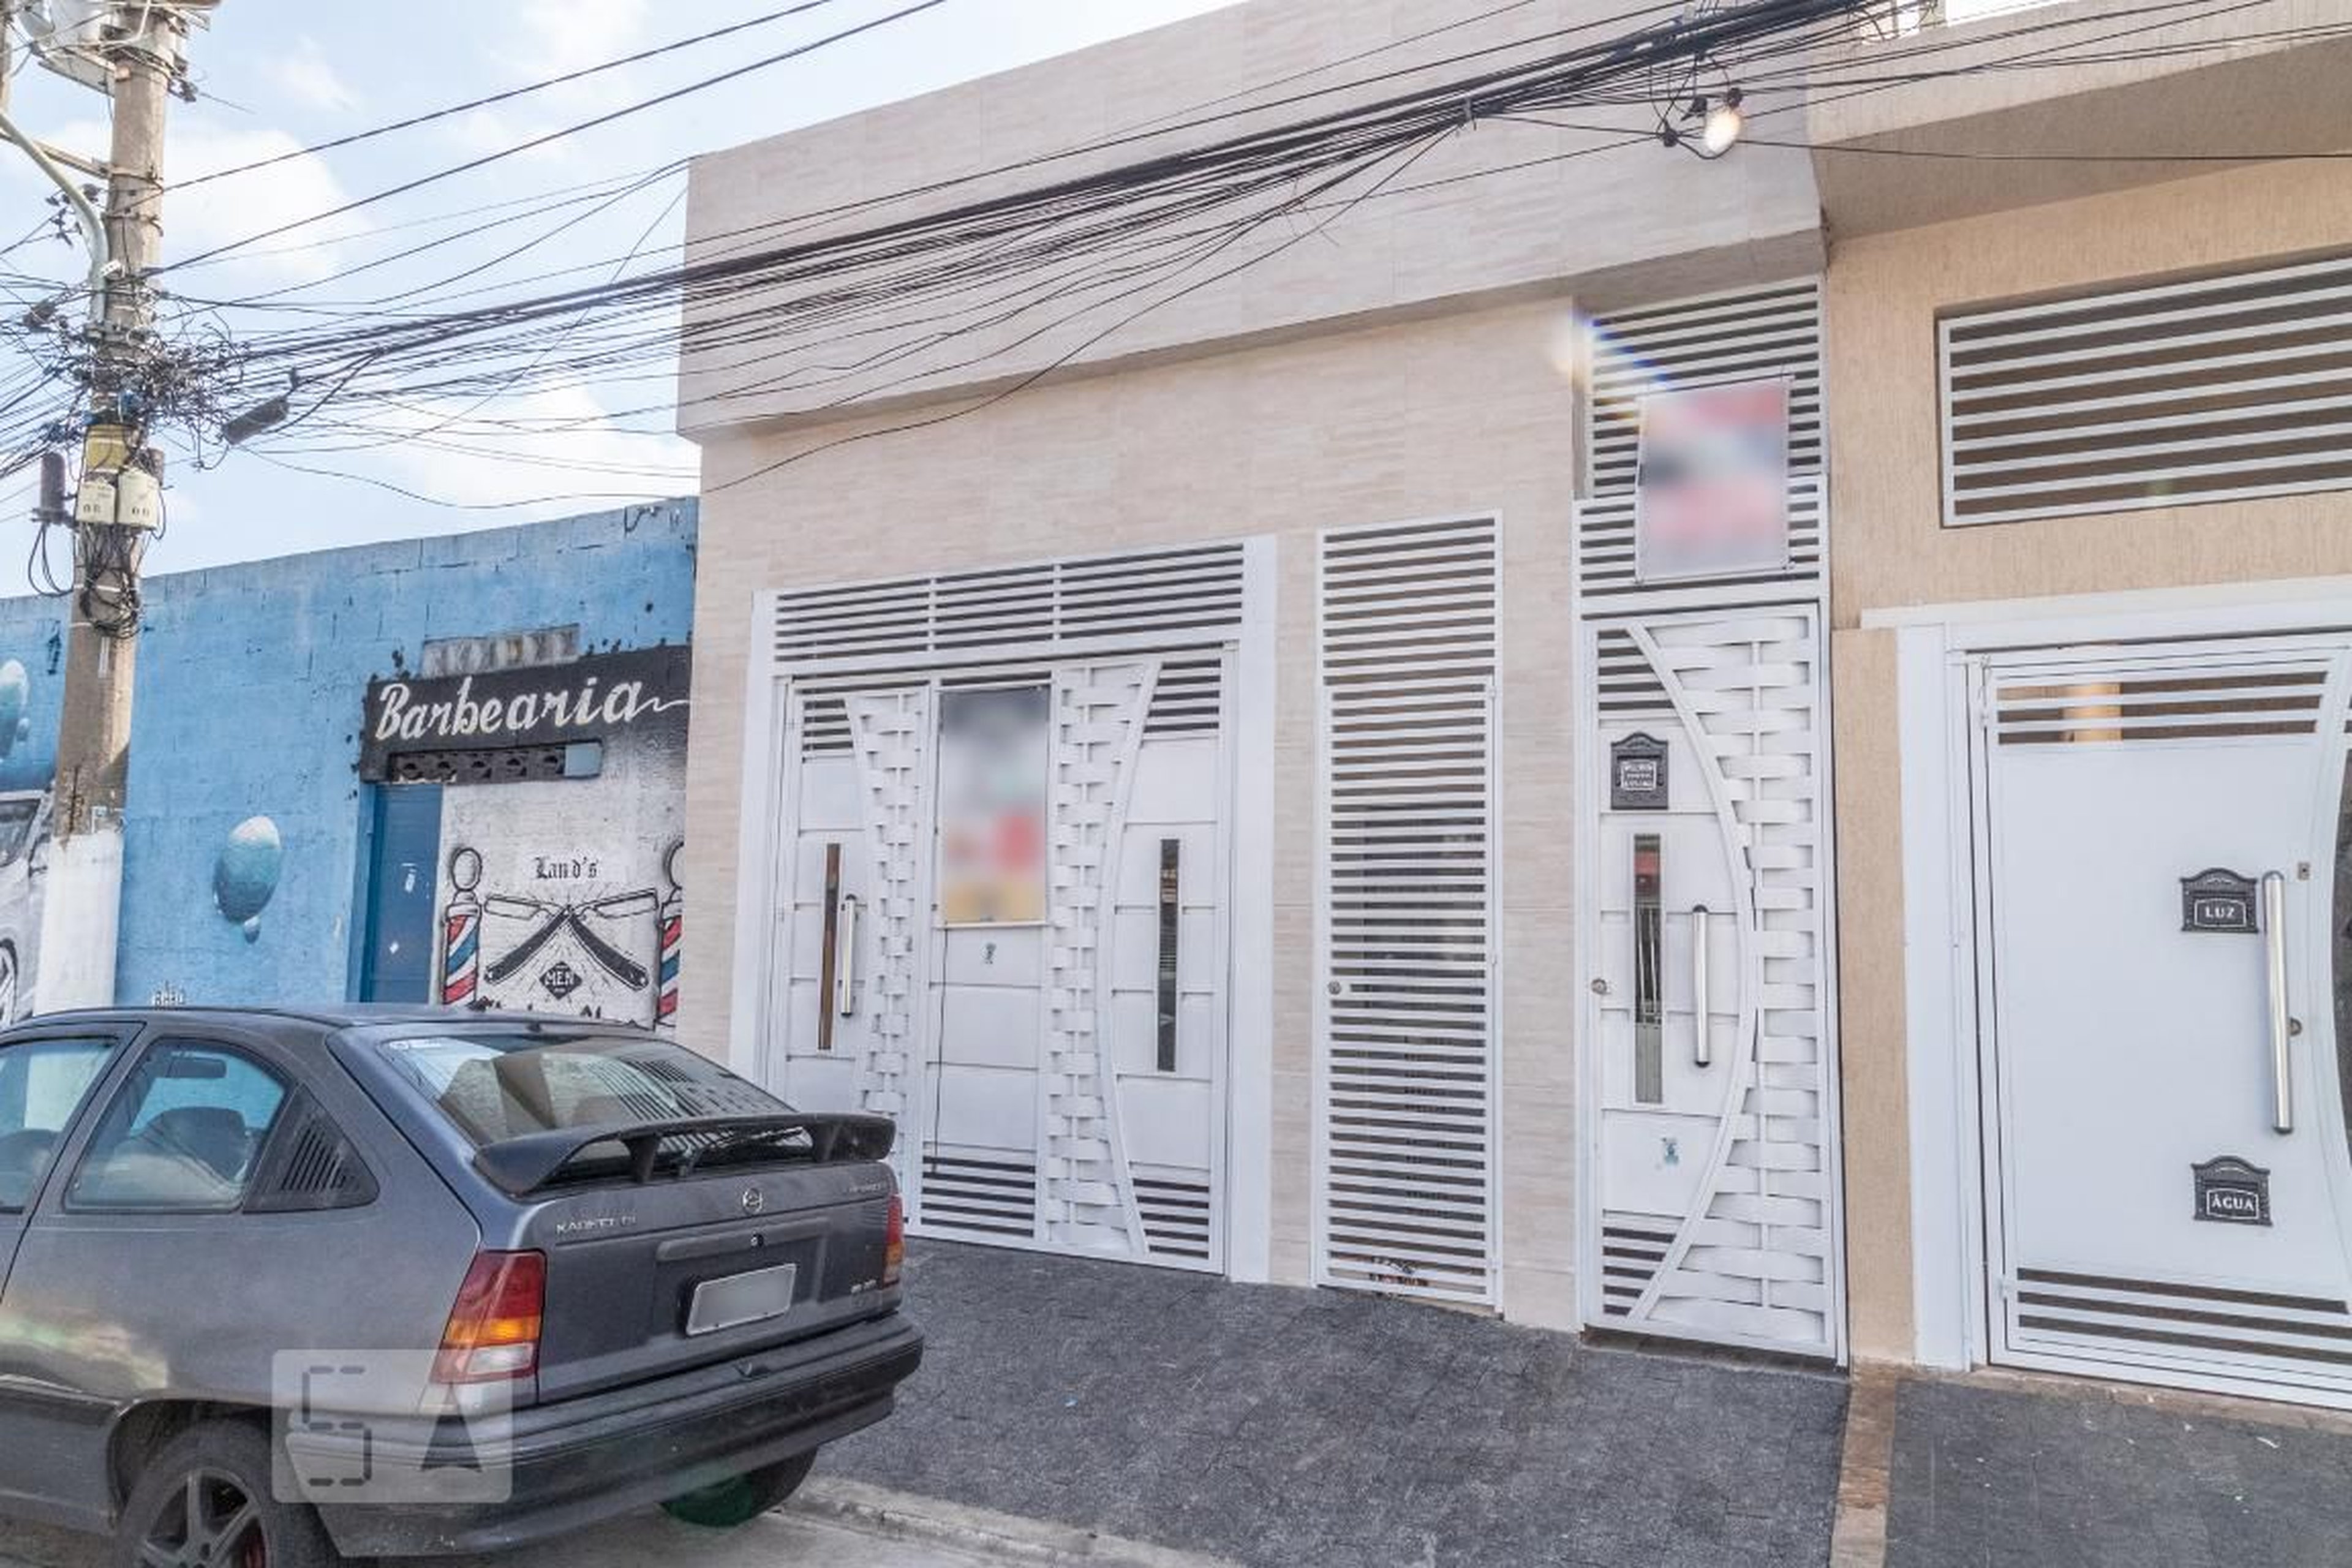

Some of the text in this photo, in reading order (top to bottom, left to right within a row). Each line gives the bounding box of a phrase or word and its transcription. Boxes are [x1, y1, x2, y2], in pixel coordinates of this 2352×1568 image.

[375, 676, 664, 741] Barbearia
[535, 856, 599, 879] Land's
[2205, 906, 2236, 919] LUZ
